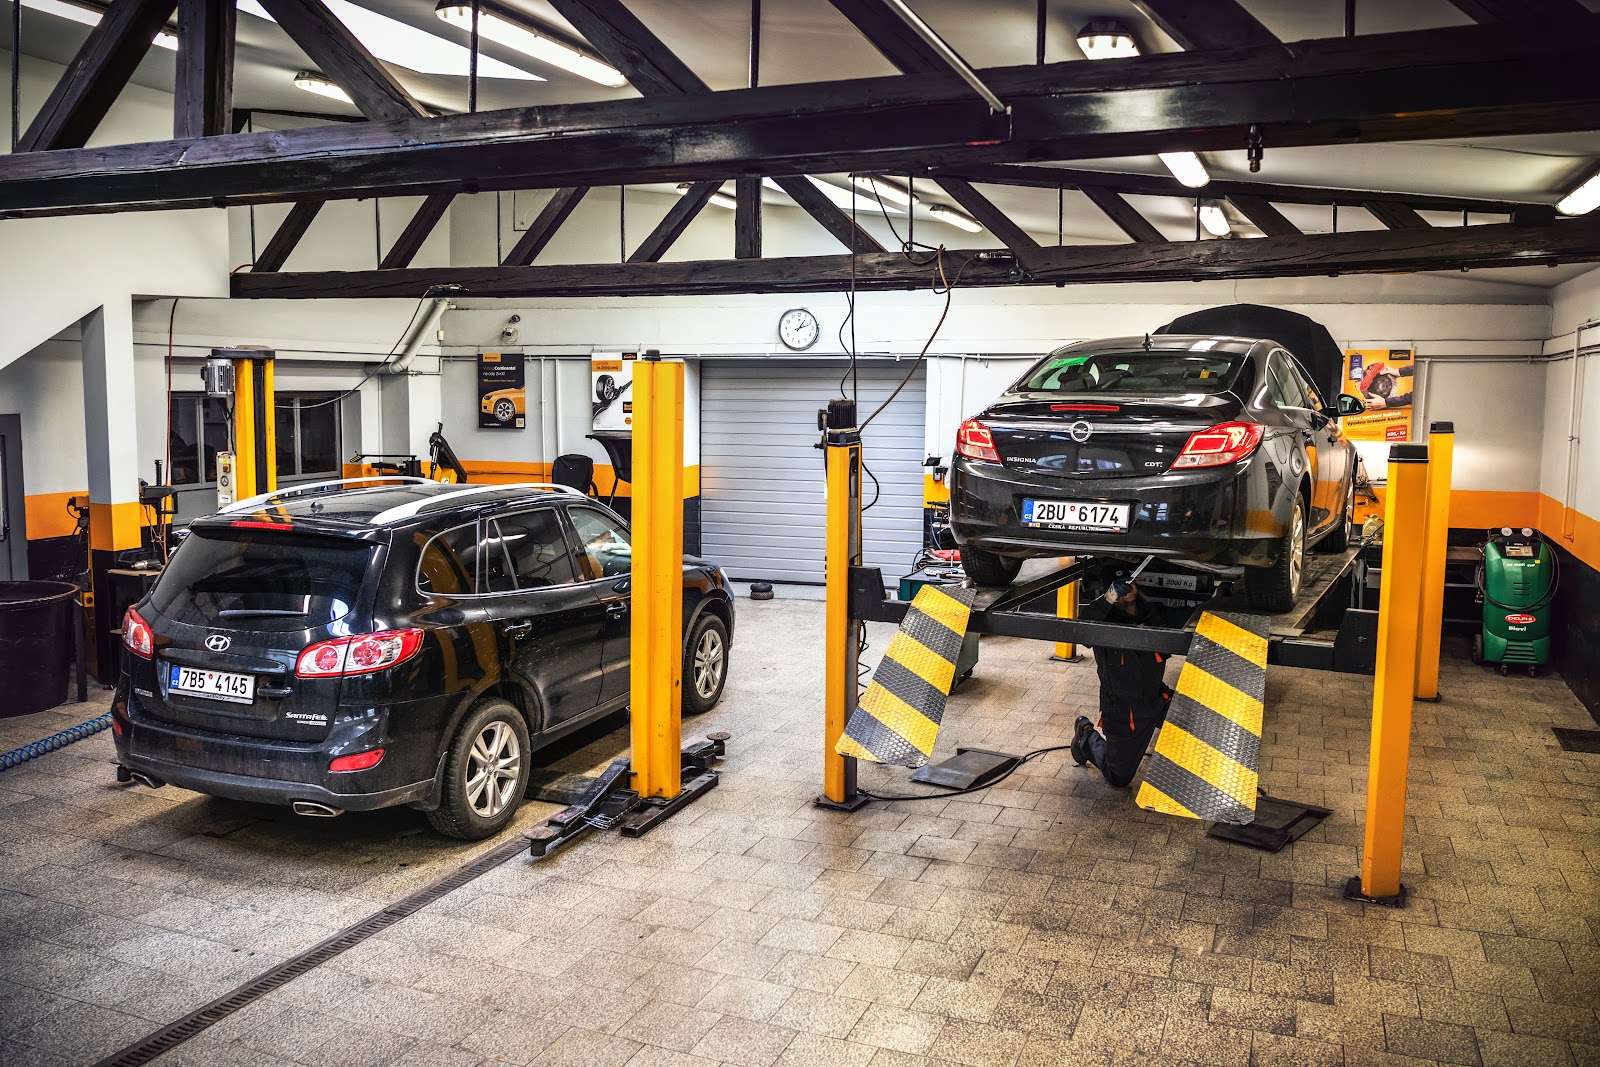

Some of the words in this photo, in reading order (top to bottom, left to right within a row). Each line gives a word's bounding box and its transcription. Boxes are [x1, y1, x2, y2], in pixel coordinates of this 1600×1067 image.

[1036, 503, 1066, 520] 2BU
[1078, 506, 1119, 524] 6174
[181, 670, 205, 688] 7B5
[215, 676, 247, 694] 4145
